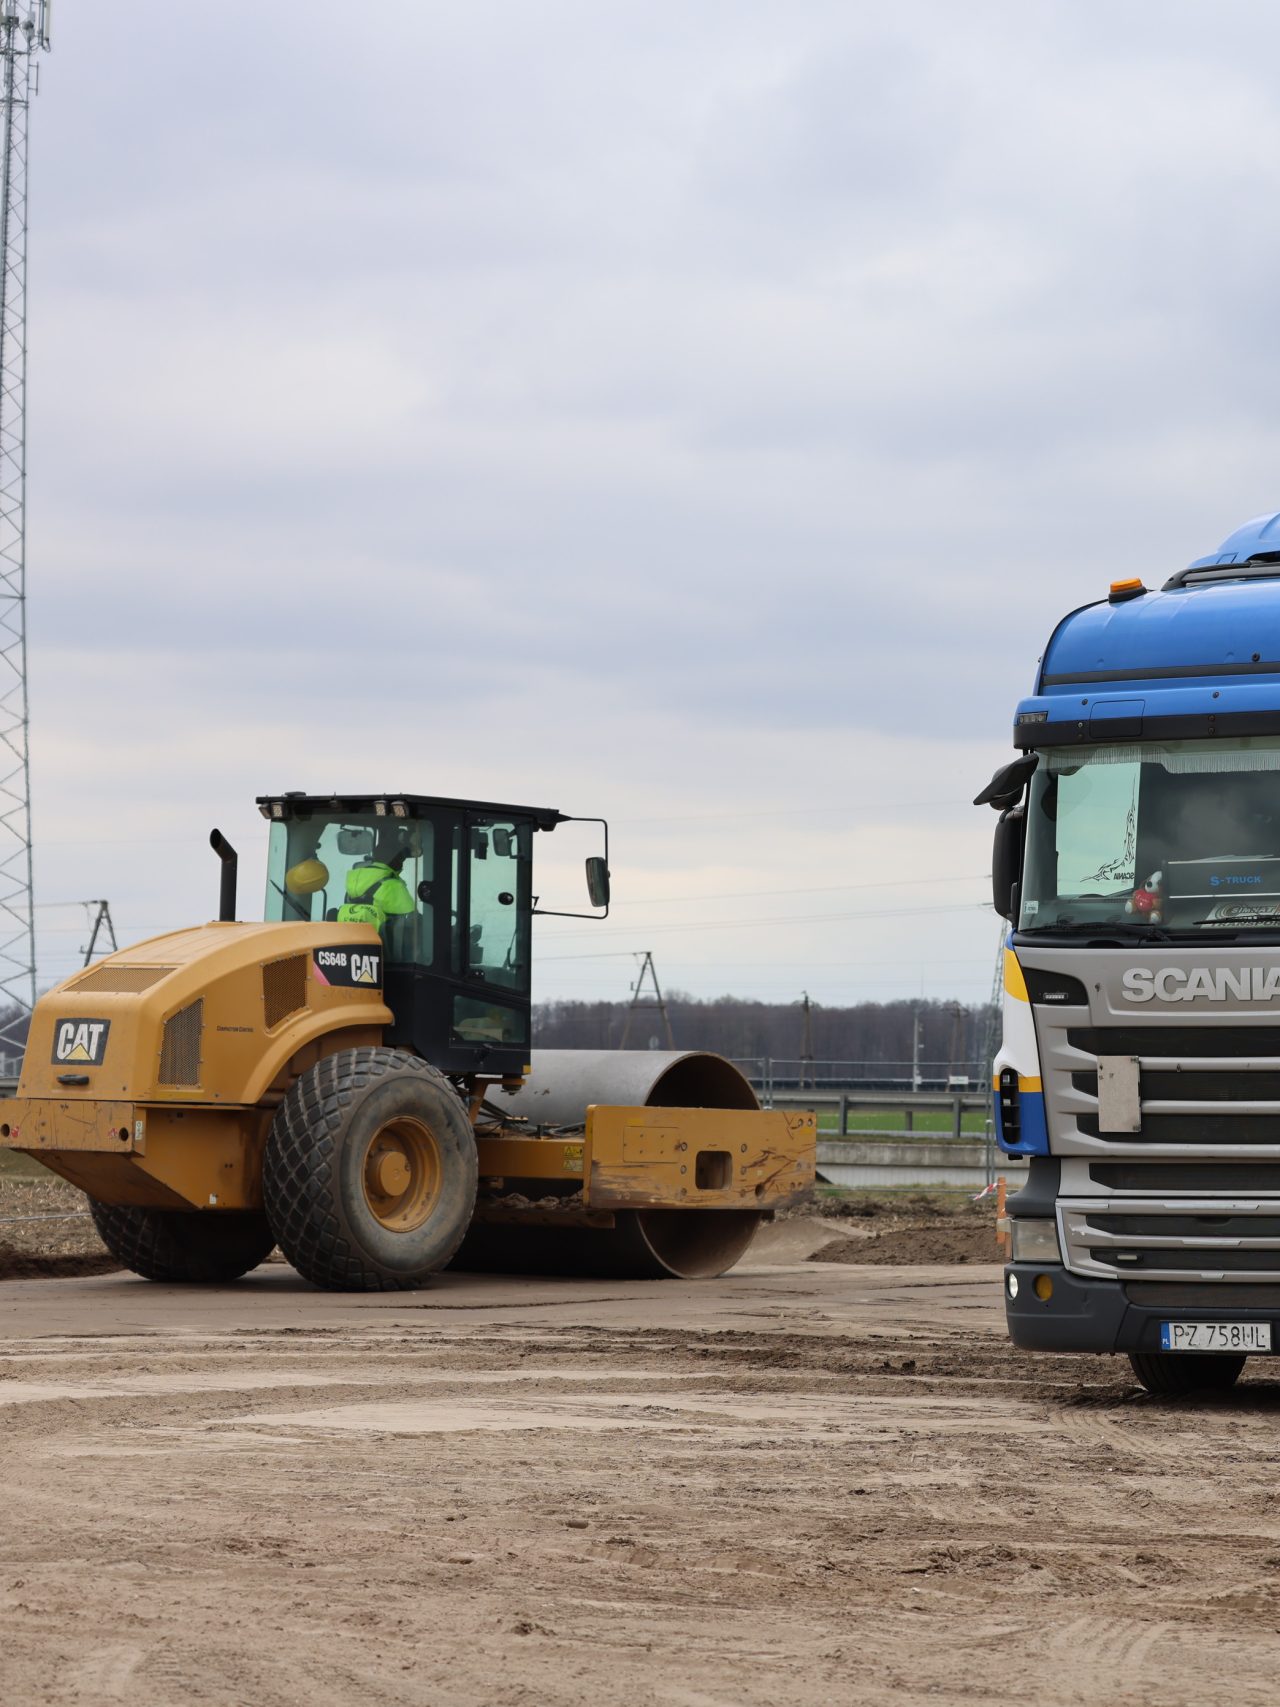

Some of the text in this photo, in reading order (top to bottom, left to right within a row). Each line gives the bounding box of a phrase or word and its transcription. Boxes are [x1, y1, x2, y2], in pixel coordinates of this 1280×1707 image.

[1210, 875, 1261, 887] S-TRUCK
[318, 951, 379, 983] CS64B CAT
[56, 1022, 105, 1061] CAT
[1173, 1325, 1198, 1347] PZ
